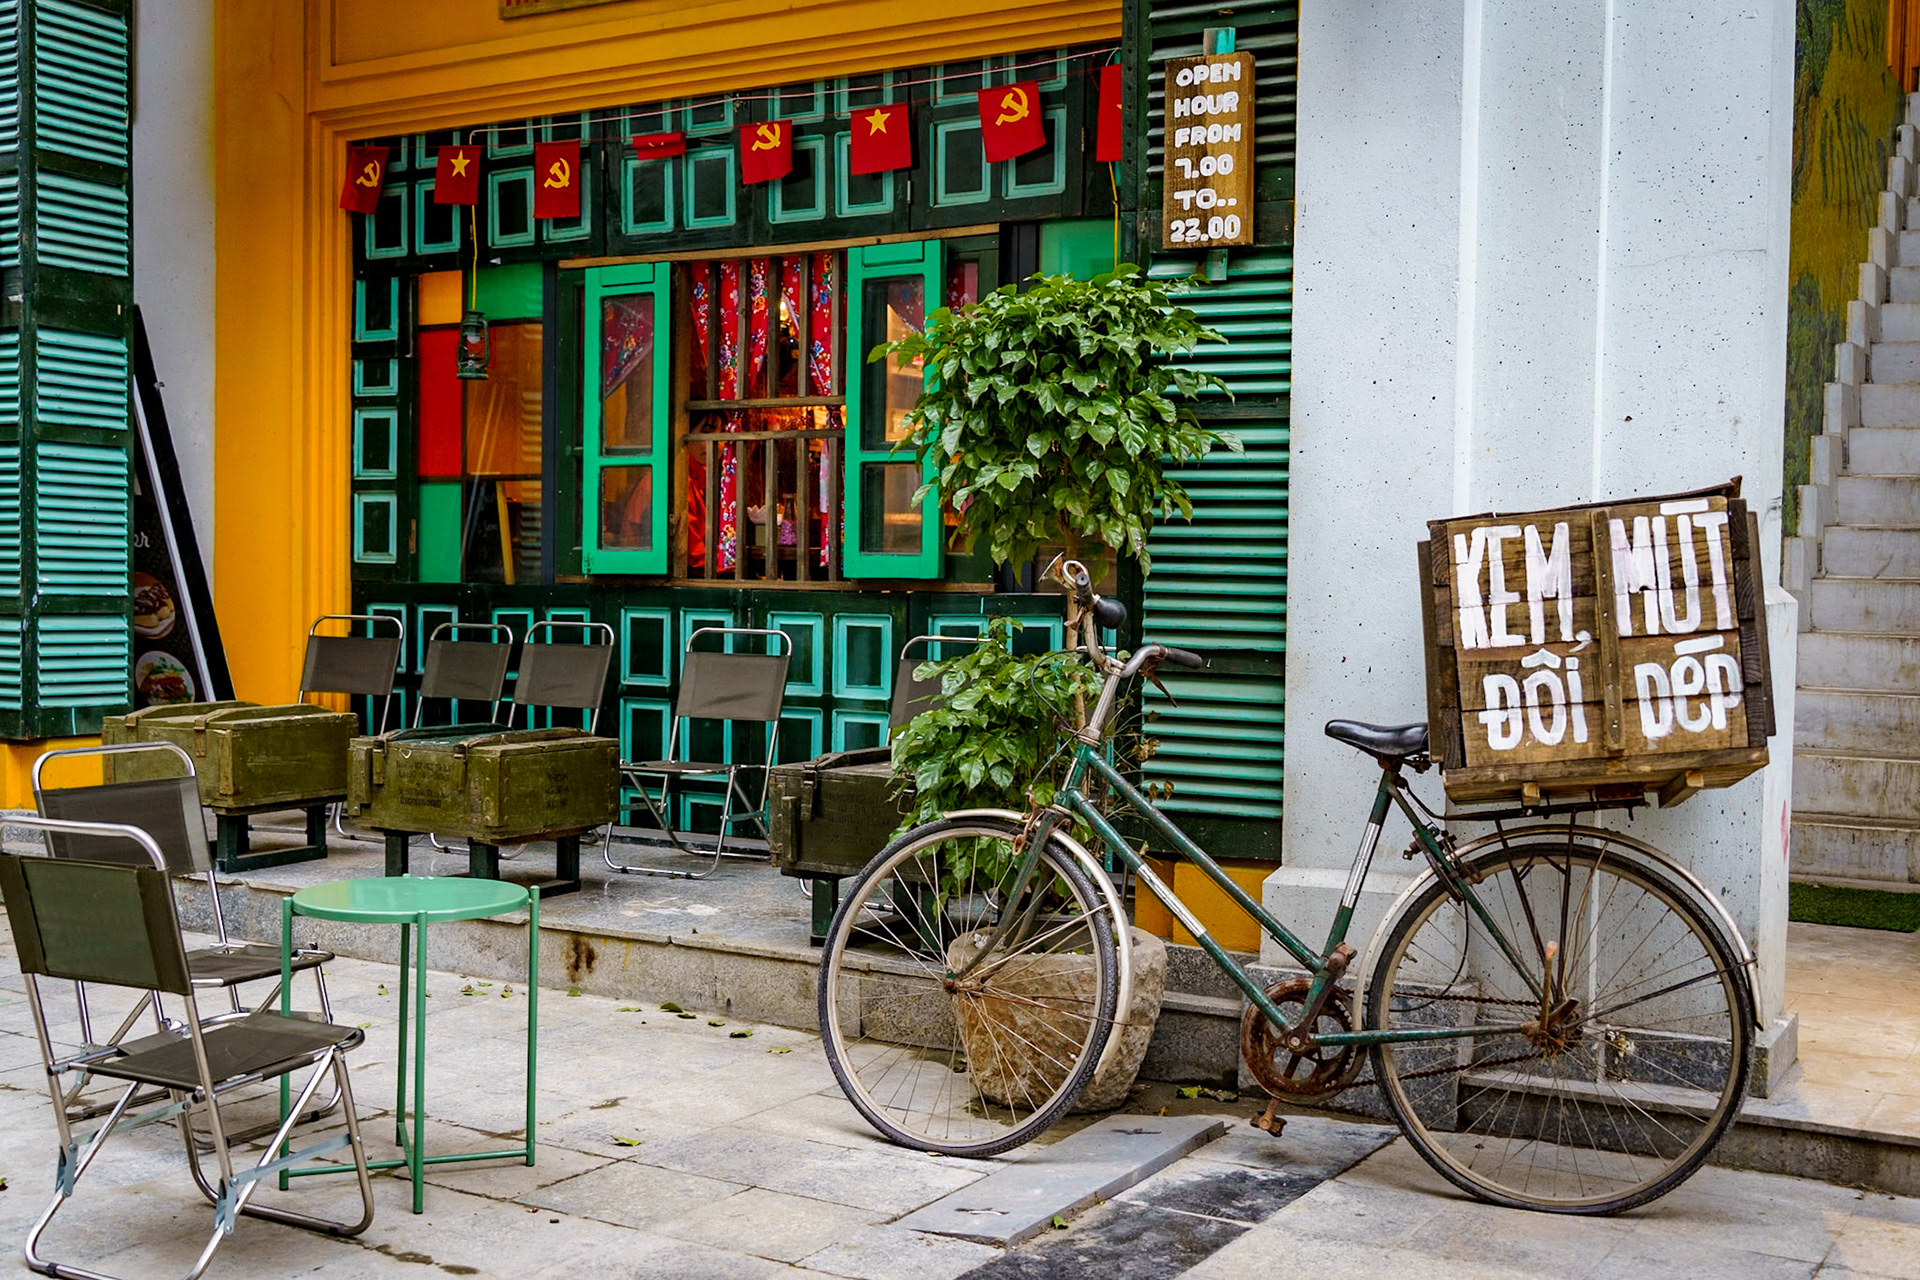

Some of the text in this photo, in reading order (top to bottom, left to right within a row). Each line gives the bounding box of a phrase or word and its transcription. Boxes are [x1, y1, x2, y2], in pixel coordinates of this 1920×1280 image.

[1175, 61, 1241, 87] OPEN
[1174, 91, 1239, 118] HOUR
[1174, 123, 1242, 148] FROM
[1174, 153, 1234, 179] 7.00
[1170, 214, 1241, 243] 23.00
[1453, 522, 1575, 649] KEM
